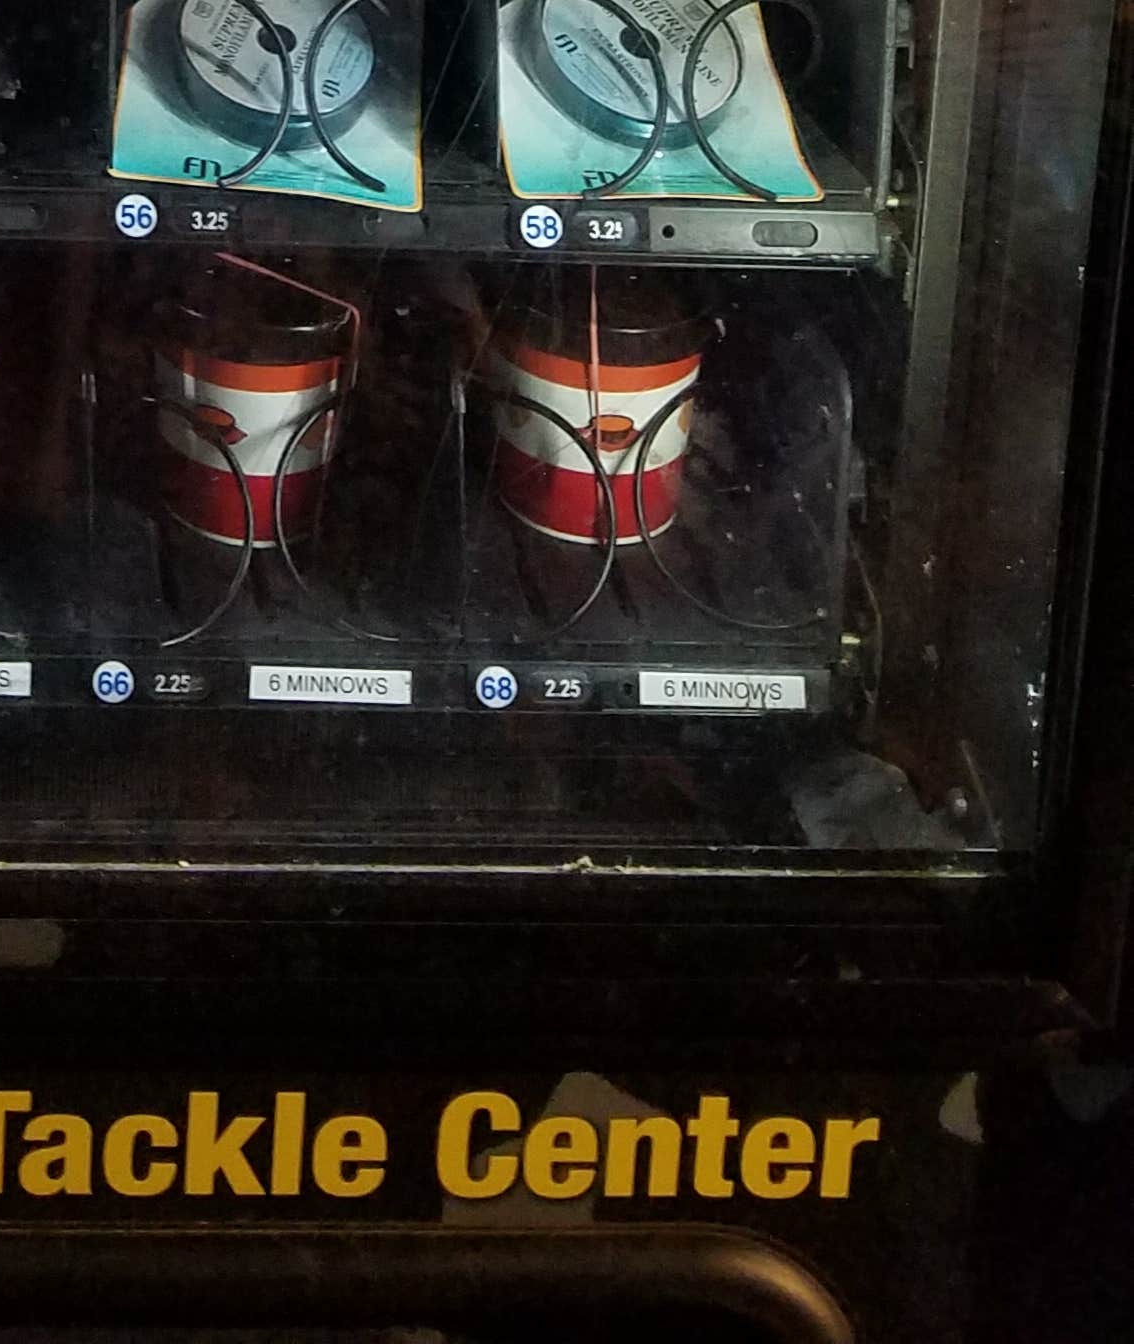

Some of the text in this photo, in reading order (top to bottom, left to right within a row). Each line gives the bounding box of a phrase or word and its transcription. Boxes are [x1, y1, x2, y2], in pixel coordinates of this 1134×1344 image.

[120, 204, 228, 230] 56 3.25
[525, 216, 623, 239] 58 3.25
[96, 669, 389, 696] 66 2.25 6 MINNOWS
[480, 674, 782, 702] 68 2.25 6 MINNOWS
[436, 1090, 881, 1199] Center
